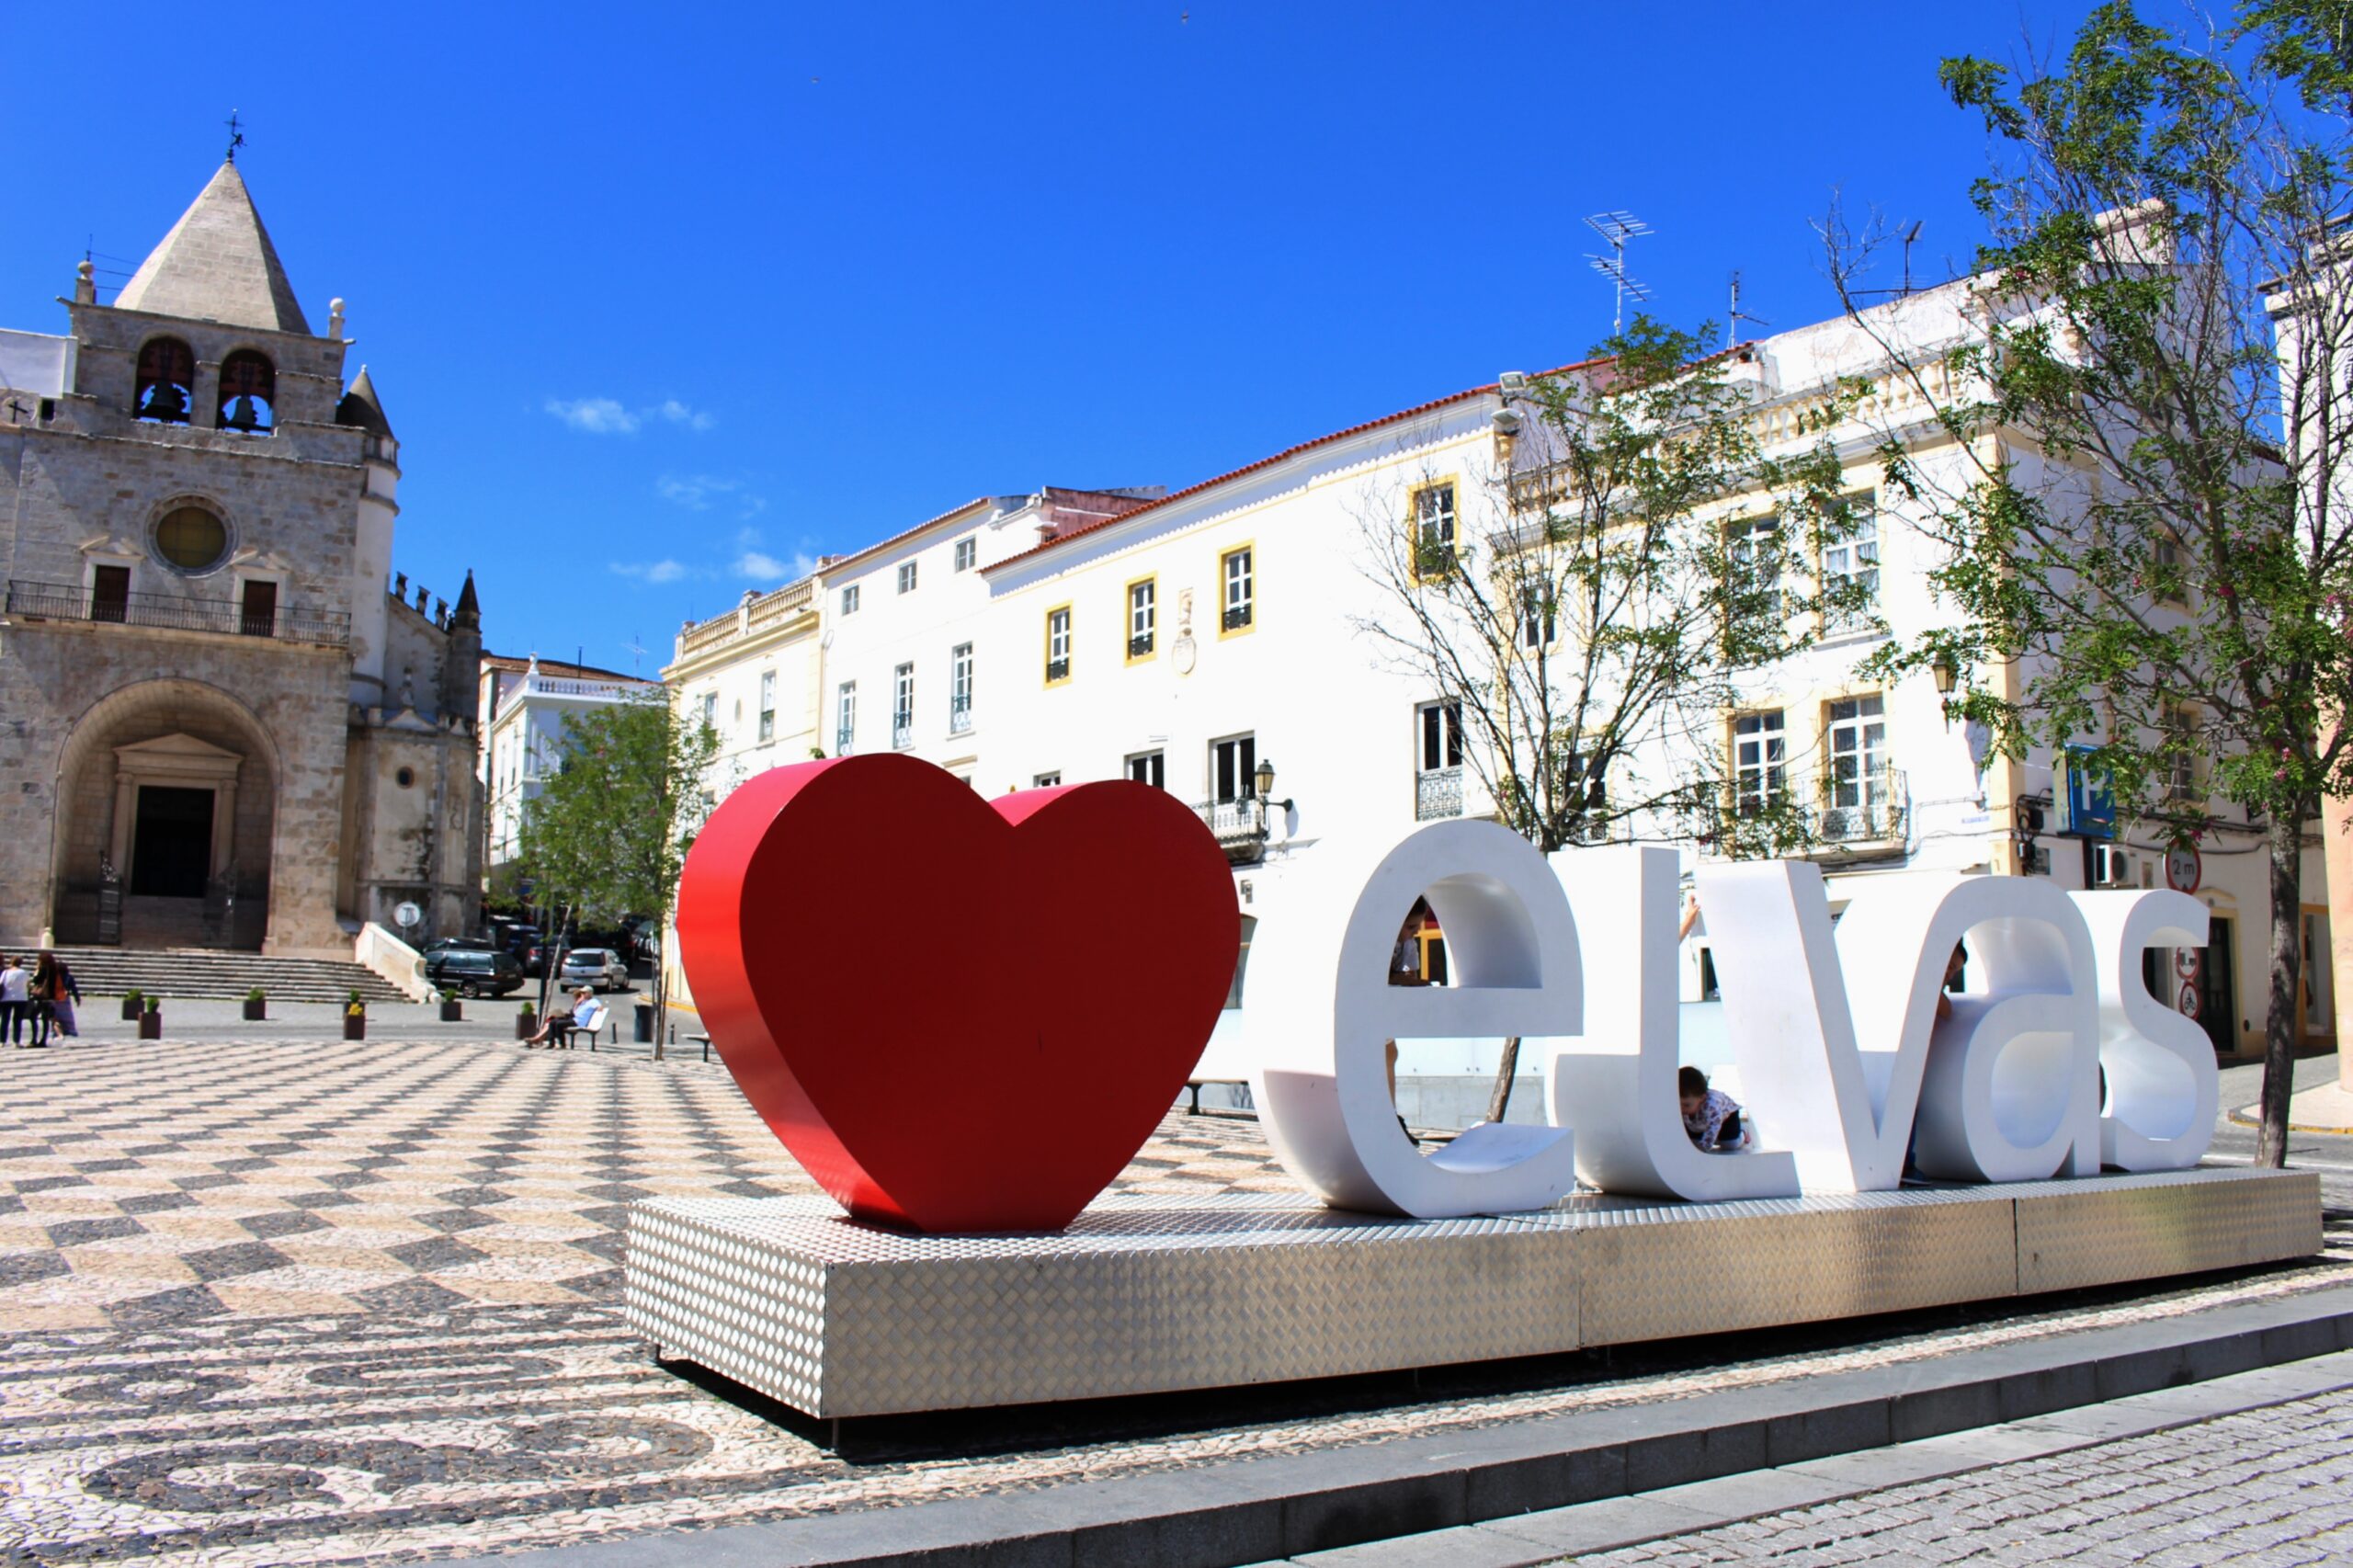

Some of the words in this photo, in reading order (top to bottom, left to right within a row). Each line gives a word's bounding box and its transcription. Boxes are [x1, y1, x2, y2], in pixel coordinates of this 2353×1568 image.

[2173, 858, 2181, 875] 2
[2184, 863, 2195, 875] m
[1245, 820, 2219, 1219] elvas
